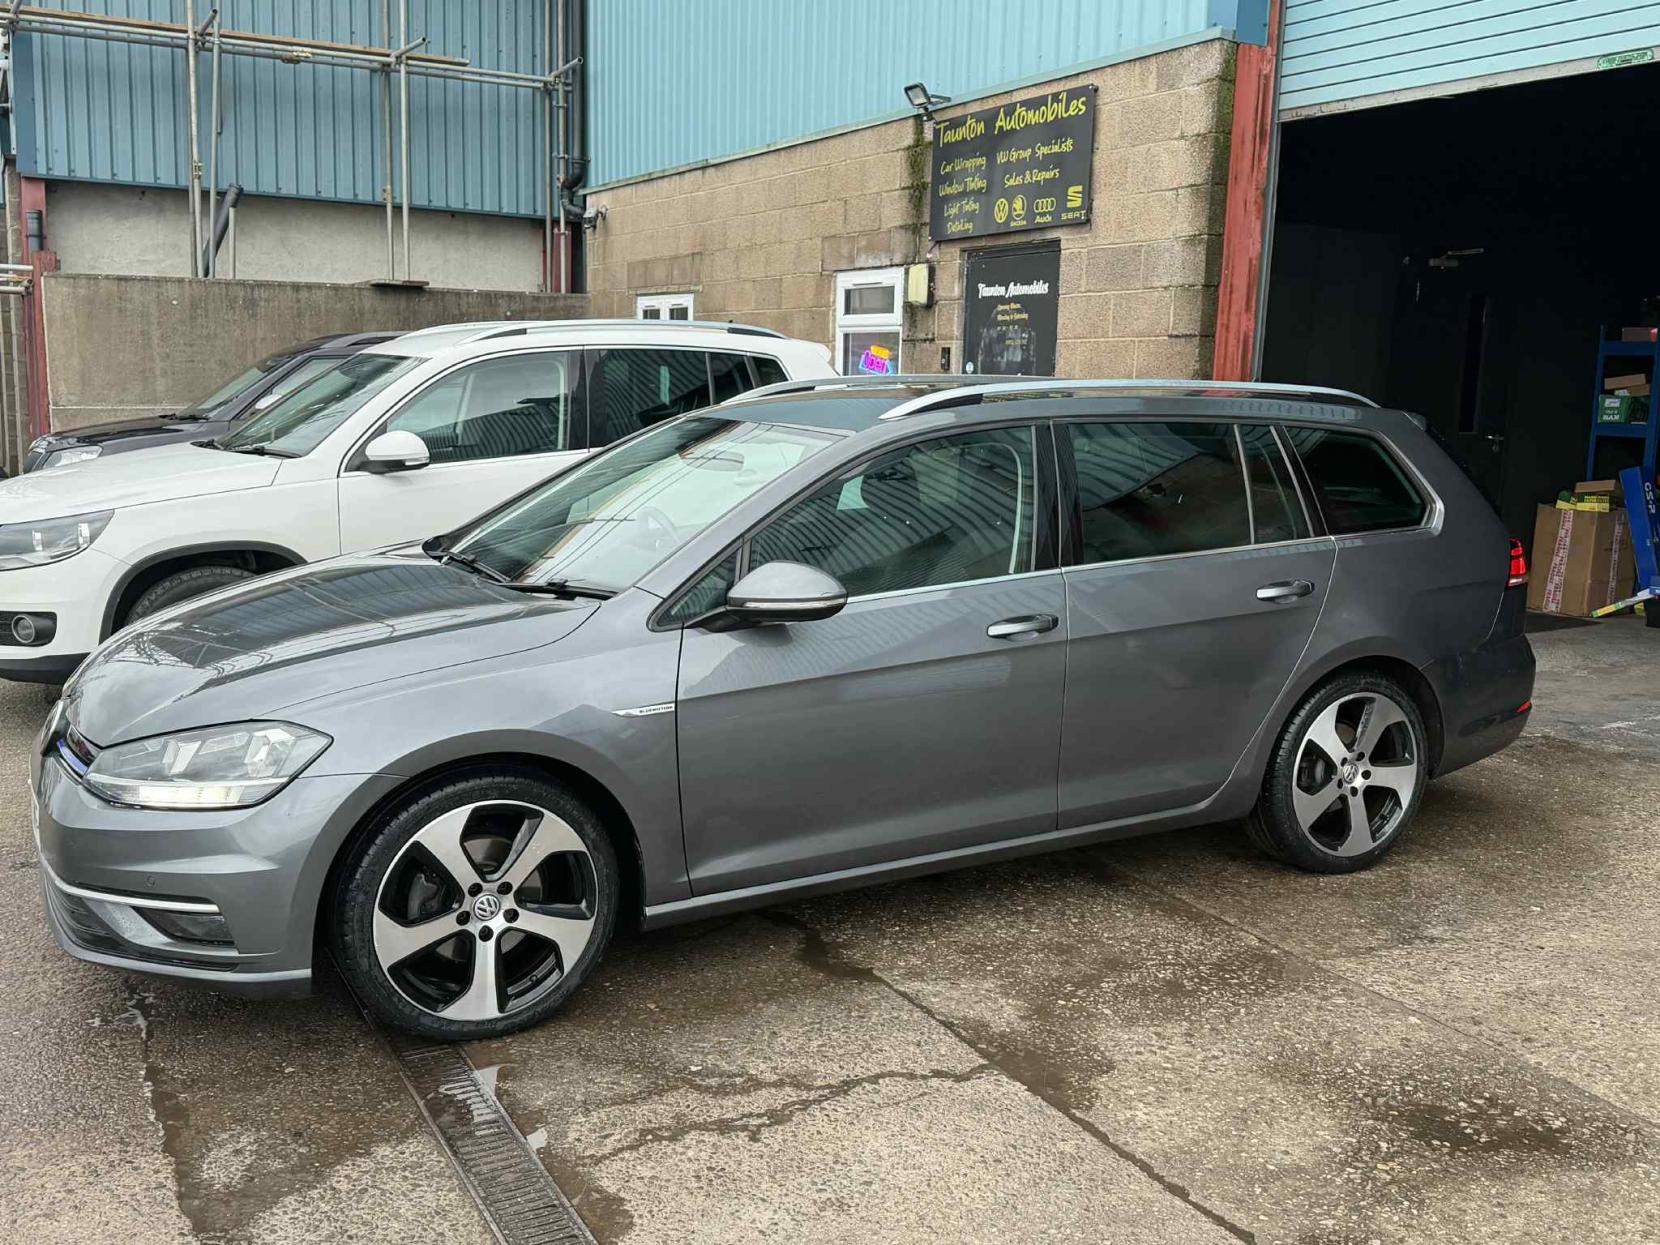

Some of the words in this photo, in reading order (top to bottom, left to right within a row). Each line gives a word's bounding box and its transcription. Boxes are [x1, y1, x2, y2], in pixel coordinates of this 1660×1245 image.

[935, 115, 985, 147] Taunton
[994, 92, 1086, 135] Automobiles
[997, 151, 1009, 165] VW
[1009, 148, 1032, 163] Group
[1035, 137, 1073, 160] Specialists
[940, 161, 954, 175] Car
[954, 152, 987, 173] Wrapping
[938, 179, 964, 197] Window
[964, 173, 987, 193] Tinting
[1004, 172, 1023, 188] Sales
[1024, 170, 1032, 184] &
[1032, 164, 1060, 185] Repairs
[944, 202, 961, 218] Light
[1034, 214, 1053, 224] Audi
[1061, 210, 1086, 220] SEAT
[947, 218, 973, 234] Detailing
[977, 283, 1006, 299] Taunton
[1005, 280, 1049, 298] Automobiles
